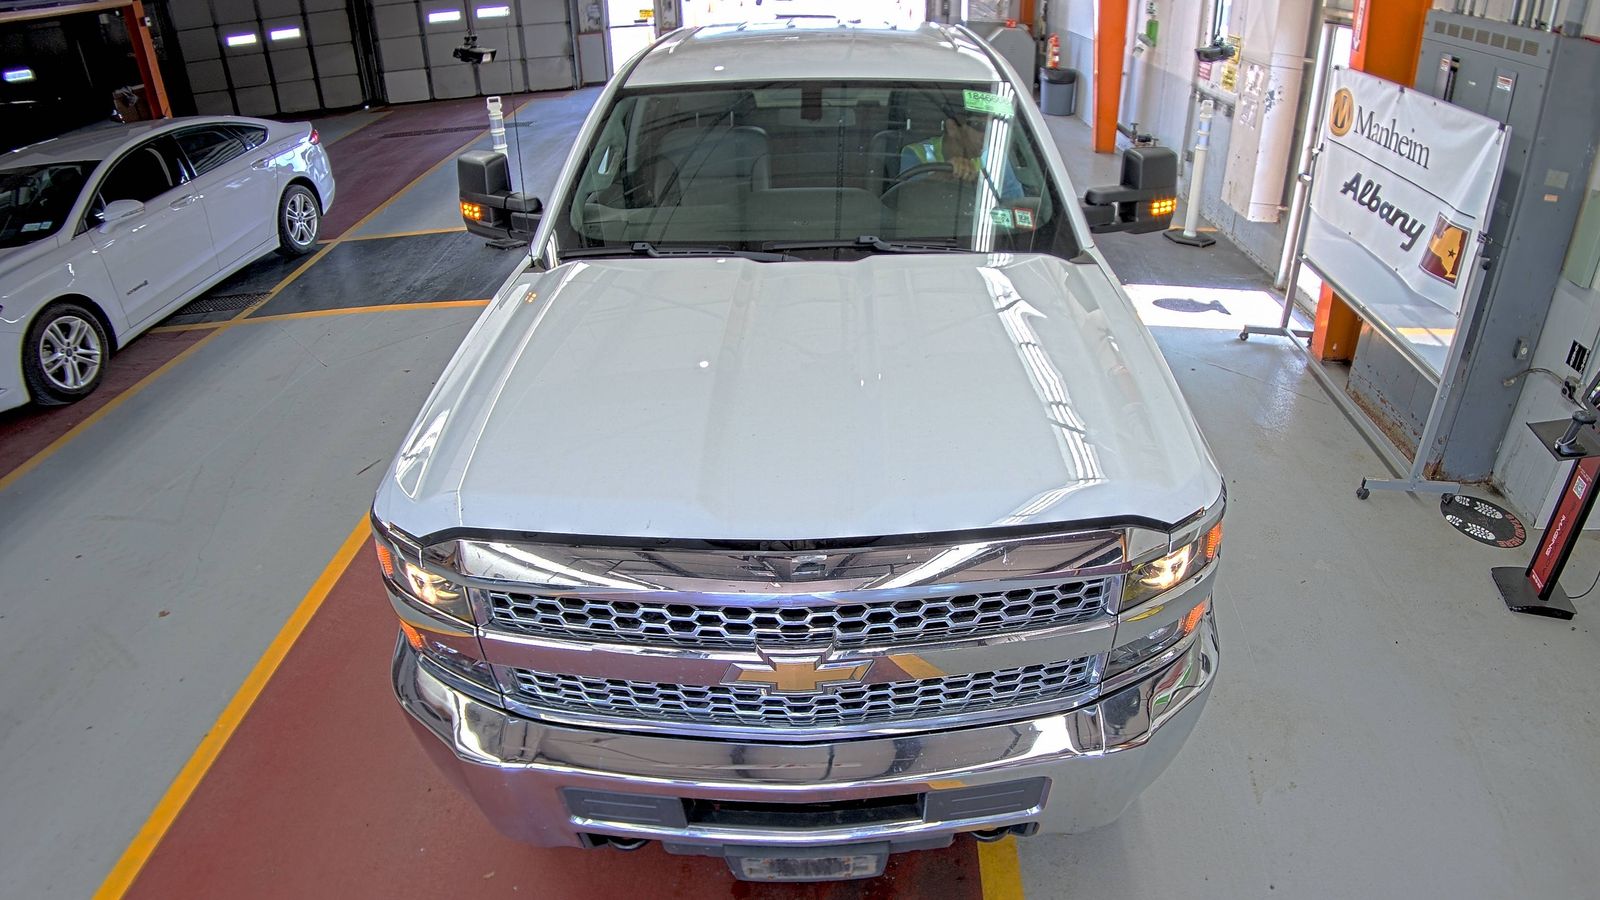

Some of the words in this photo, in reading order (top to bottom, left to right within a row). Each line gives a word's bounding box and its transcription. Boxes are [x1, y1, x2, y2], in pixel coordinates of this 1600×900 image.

[1354, 105, 1430, 170] Manheim
[1340, 172, 1426, 252] Albany
[1496, 536, 1524, 548] HERE
[1504, 513, 1525, 539] STAND
[1545, 514, 1567, 557] IMAGING
